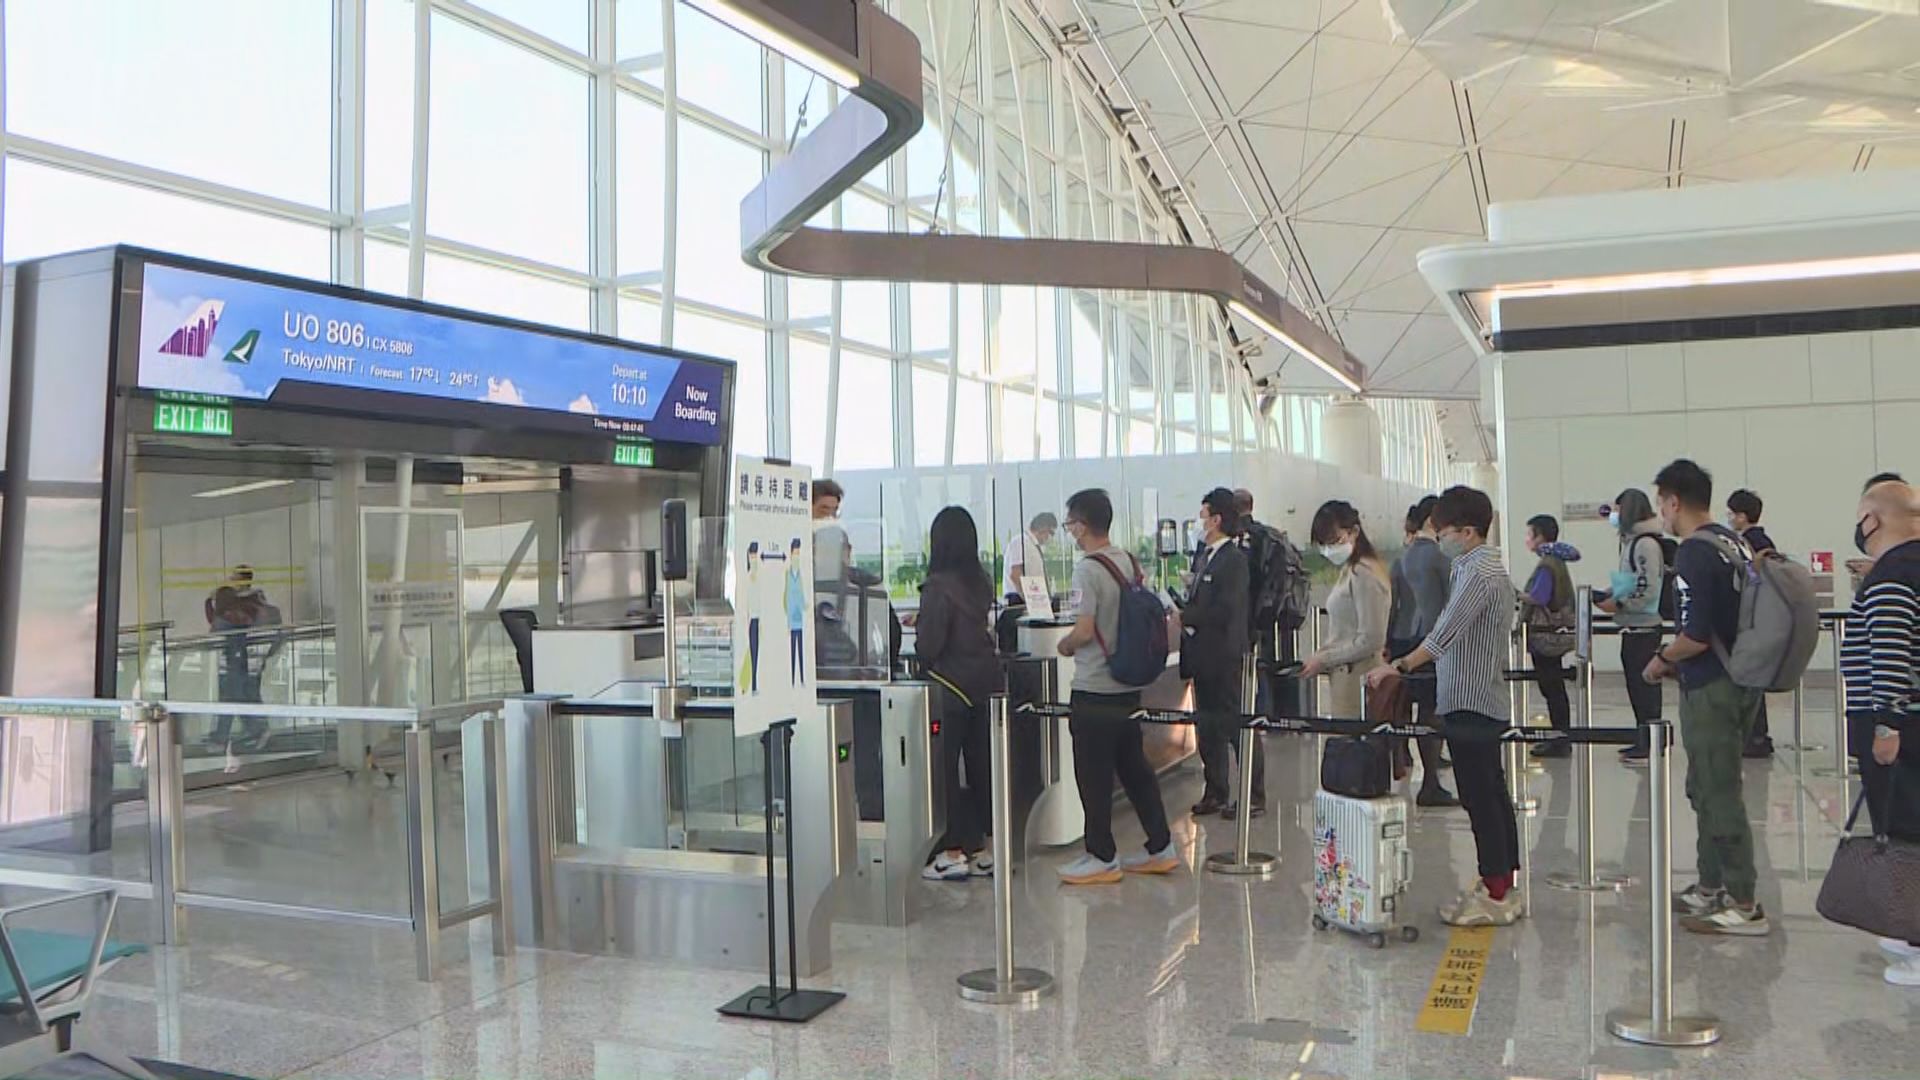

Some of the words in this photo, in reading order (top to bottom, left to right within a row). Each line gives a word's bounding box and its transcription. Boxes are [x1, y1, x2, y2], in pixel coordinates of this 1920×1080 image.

[284, 310, 319, 341] UO
[326, 320, 364, 347] 806
[372, 337, 387, 352] CX
[283, 349, 355, 373] Tokyo/NRT
[370, 364, 403, 379] Forecast
[612, 364, 638, 380] Depart
[611, 383, 647, 406] 10:10
[686, 384, 708, 403] Now
[159, 404, 198, 431] EXIT
[202, 407, 229, 433] 出口
[674, 402, 717, 425] Boarding
[615, 445, 635, 464] EXIT
[637, 447, 652, 465] 出口
[740, 473, 808, 501] 請保持距離
